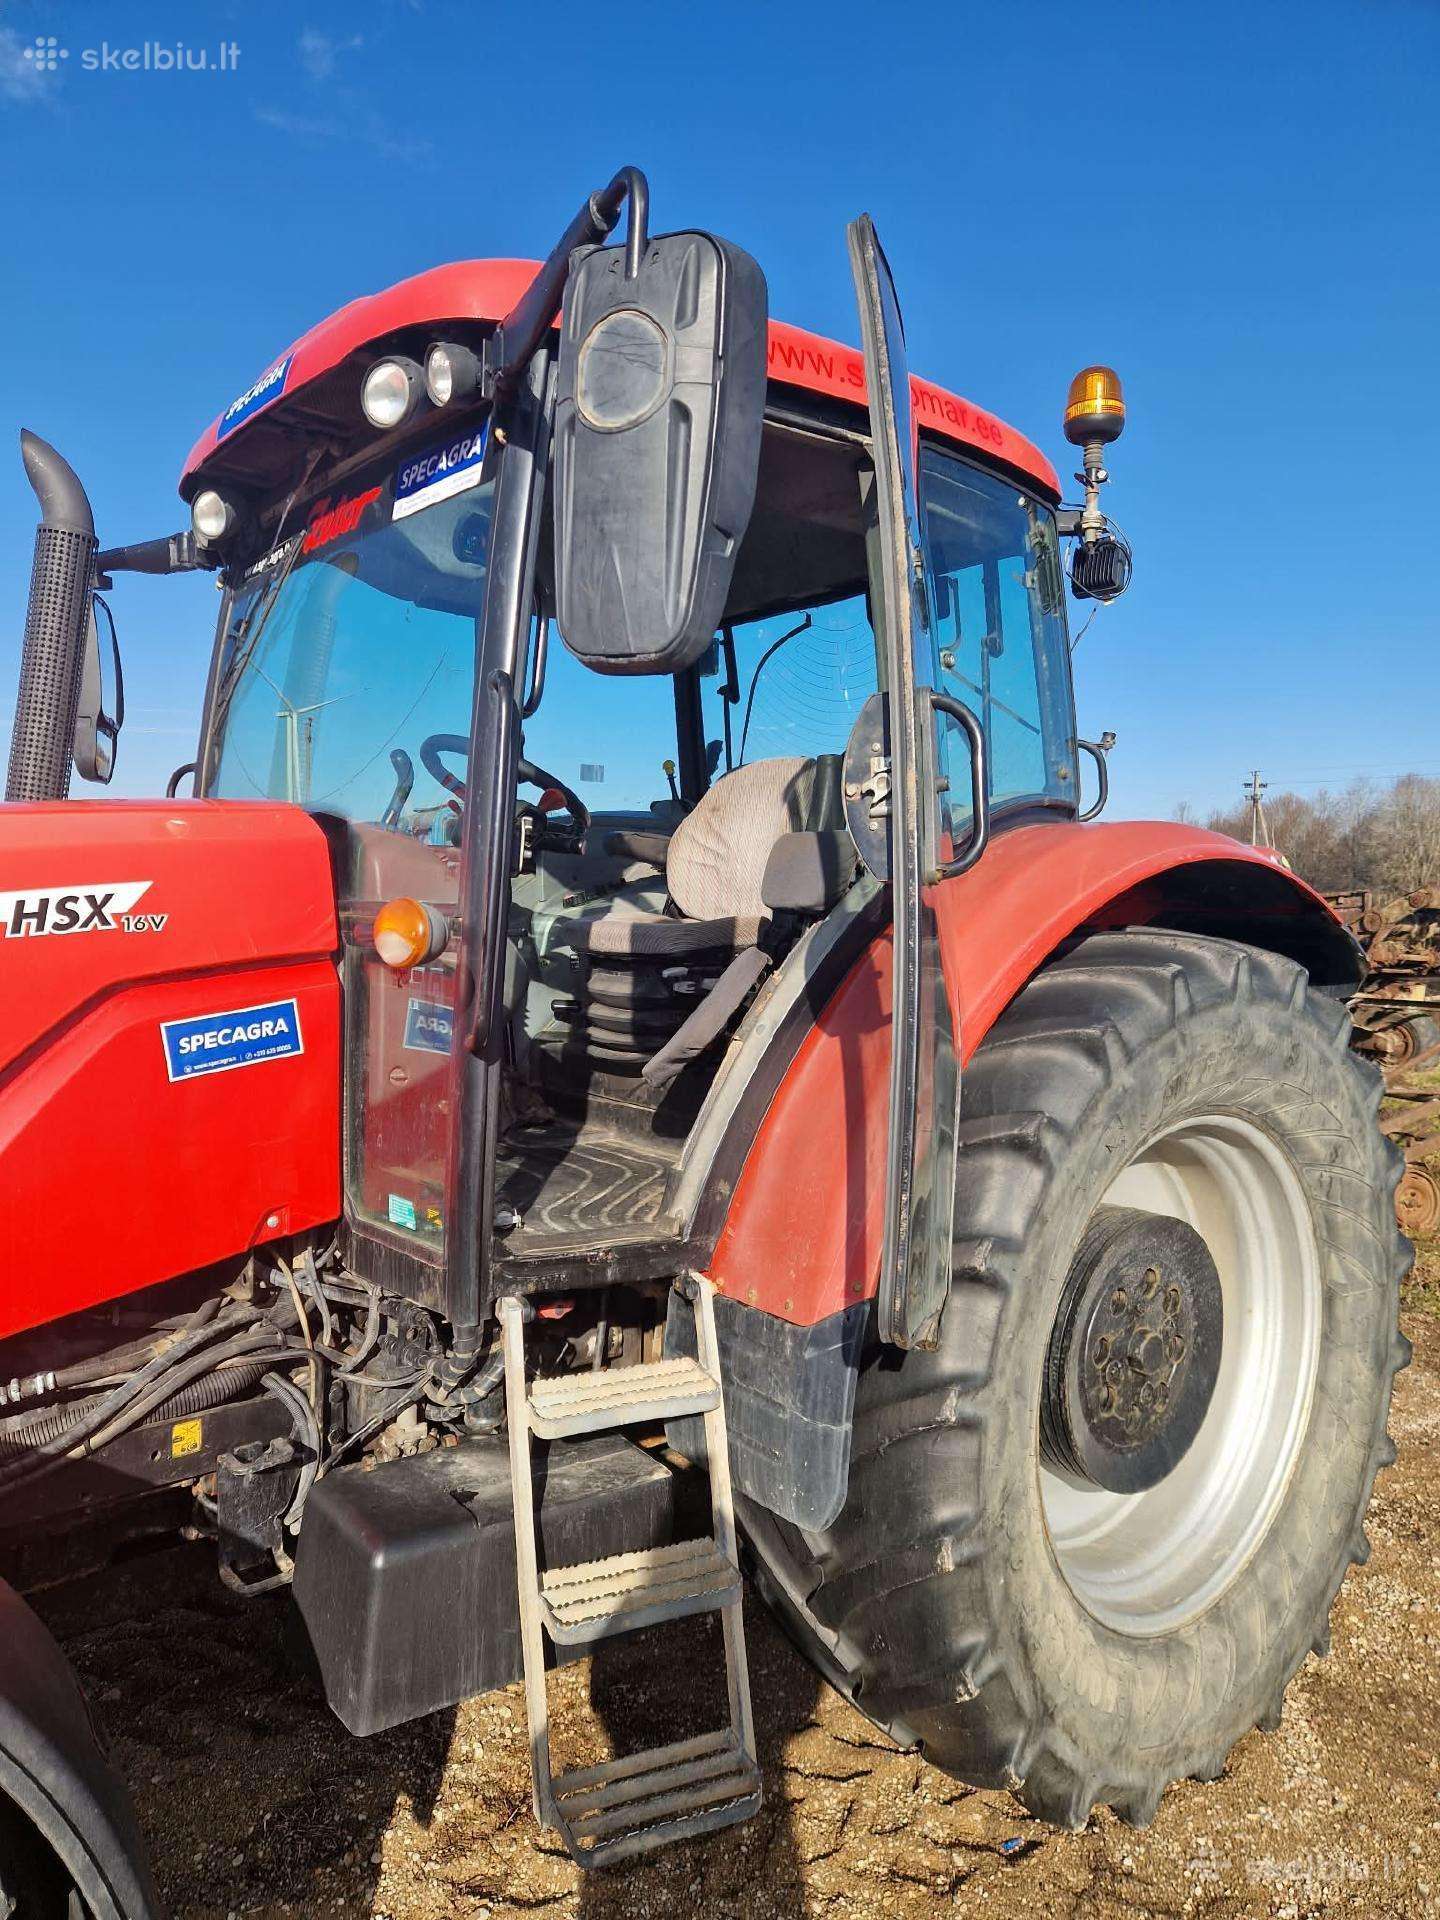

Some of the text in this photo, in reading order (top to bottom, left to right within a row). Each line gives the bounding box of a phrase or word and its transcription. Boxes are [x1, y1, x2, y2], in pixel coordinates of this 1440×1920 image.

[225, 359, 288, 420] SPECAGRA
[400, 434, 481, 489] SPECAGRA
[10, 893, 115, 934] HSX
[122, 914, 167, 932] 16V
[179, 1018, 289, 1054] SPECAGRA
